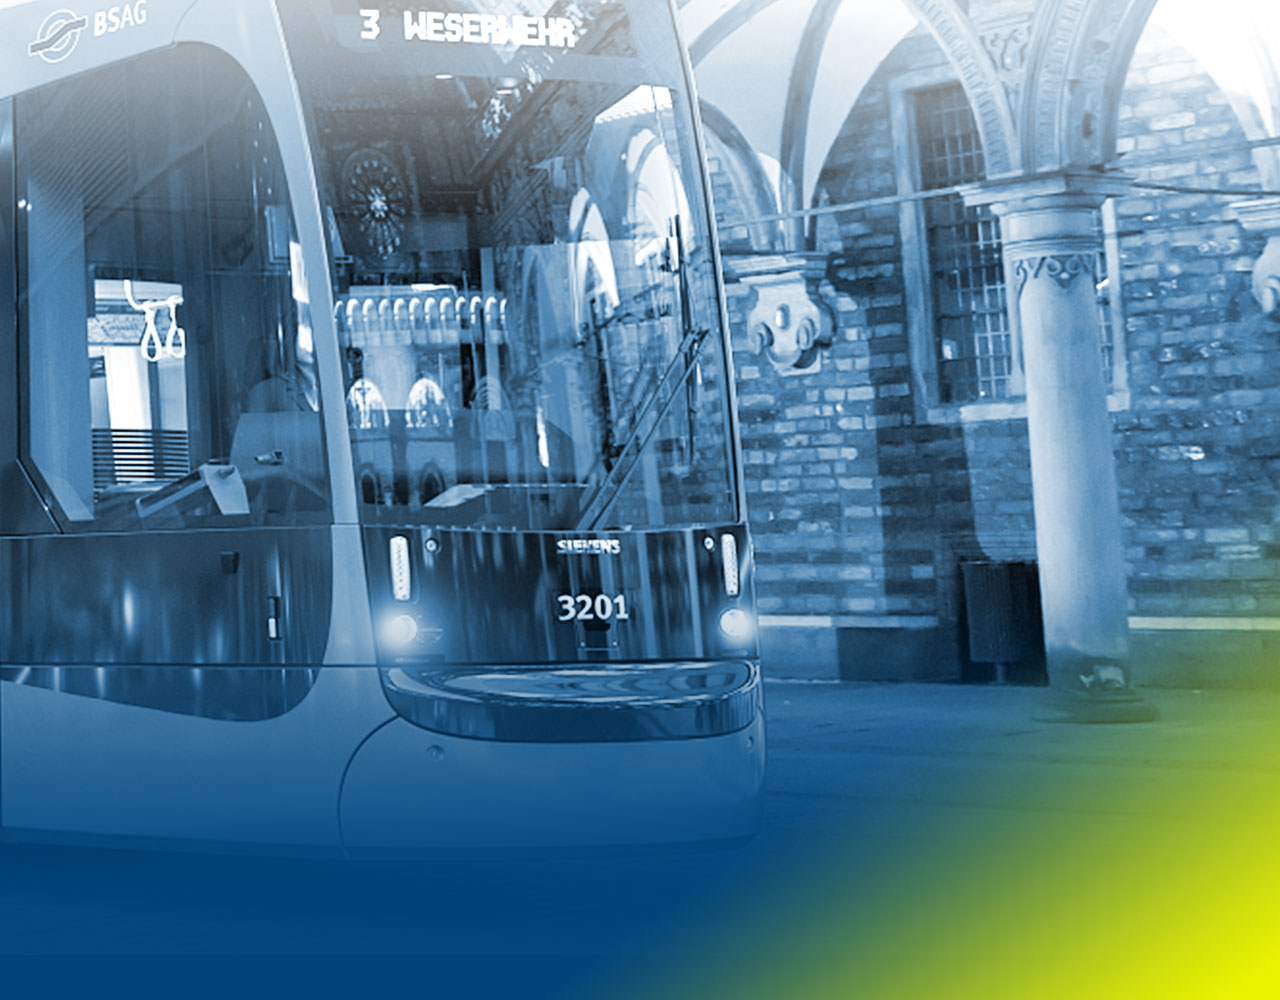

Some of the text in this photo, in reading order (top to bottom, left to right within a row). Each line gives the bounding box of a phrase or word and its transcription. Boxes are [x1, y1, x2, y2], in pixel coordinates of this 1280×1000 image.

[93, 0, 146, 37] BSAG
[359, 8, 576, 48] 3 WESERWEHR
[556, 539, 621, 554] SIEMENS
[557, 593, 630, 621] 3201
